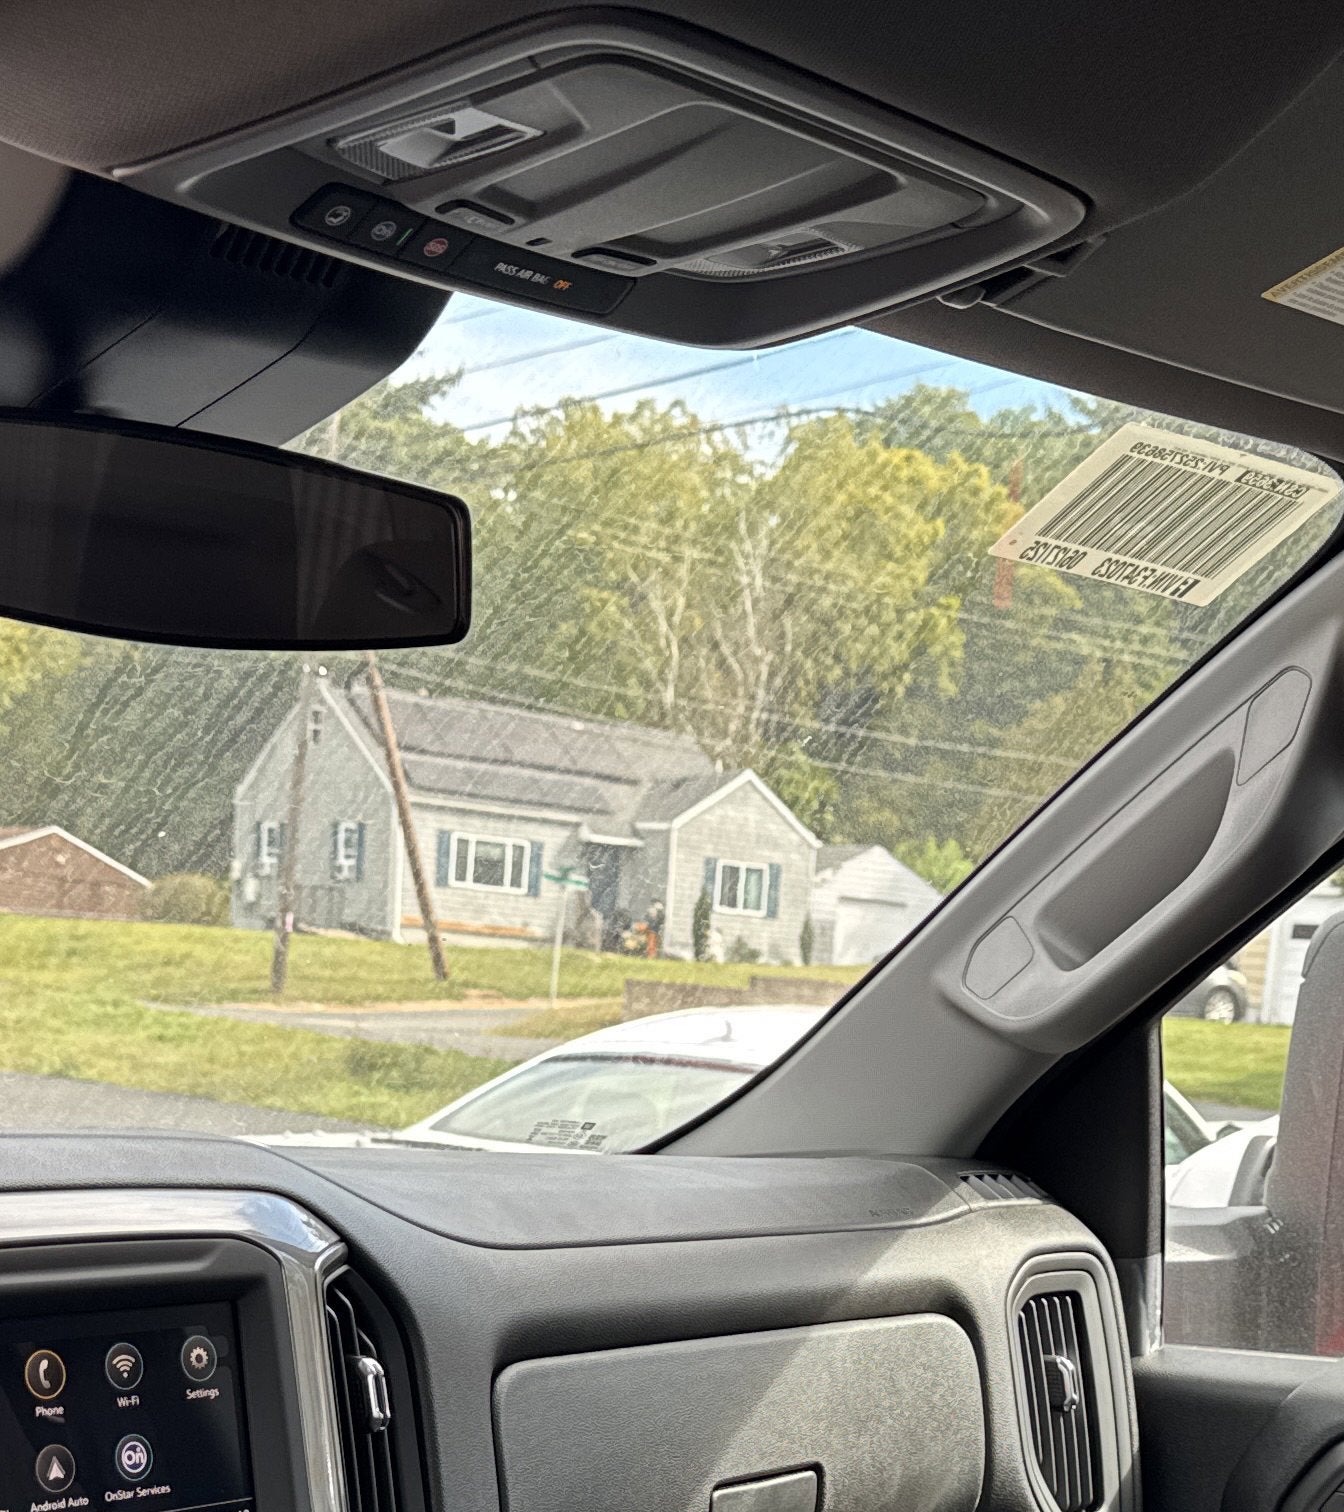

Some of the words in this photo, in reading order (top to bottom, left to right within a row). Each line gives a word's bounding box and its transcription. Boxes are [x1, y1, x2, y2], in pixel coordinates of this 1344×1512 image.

[494, 262, 519, 276] PASS
[516, 268, 534, 280] AIR
[553, 279, 572, 290] OFF
[186, 1387, 220, 1400] Settings
[116, 1395, 140, 1408] Wi-Fi
[35, 1406, 65, 1417] Phone
[105, 1490, 135, 1502] OnStar
[136, 1484, 171, 1498] Services
[30, 1498, 66, 1512] Android
[67, 1496, 90, 1508] Auto
